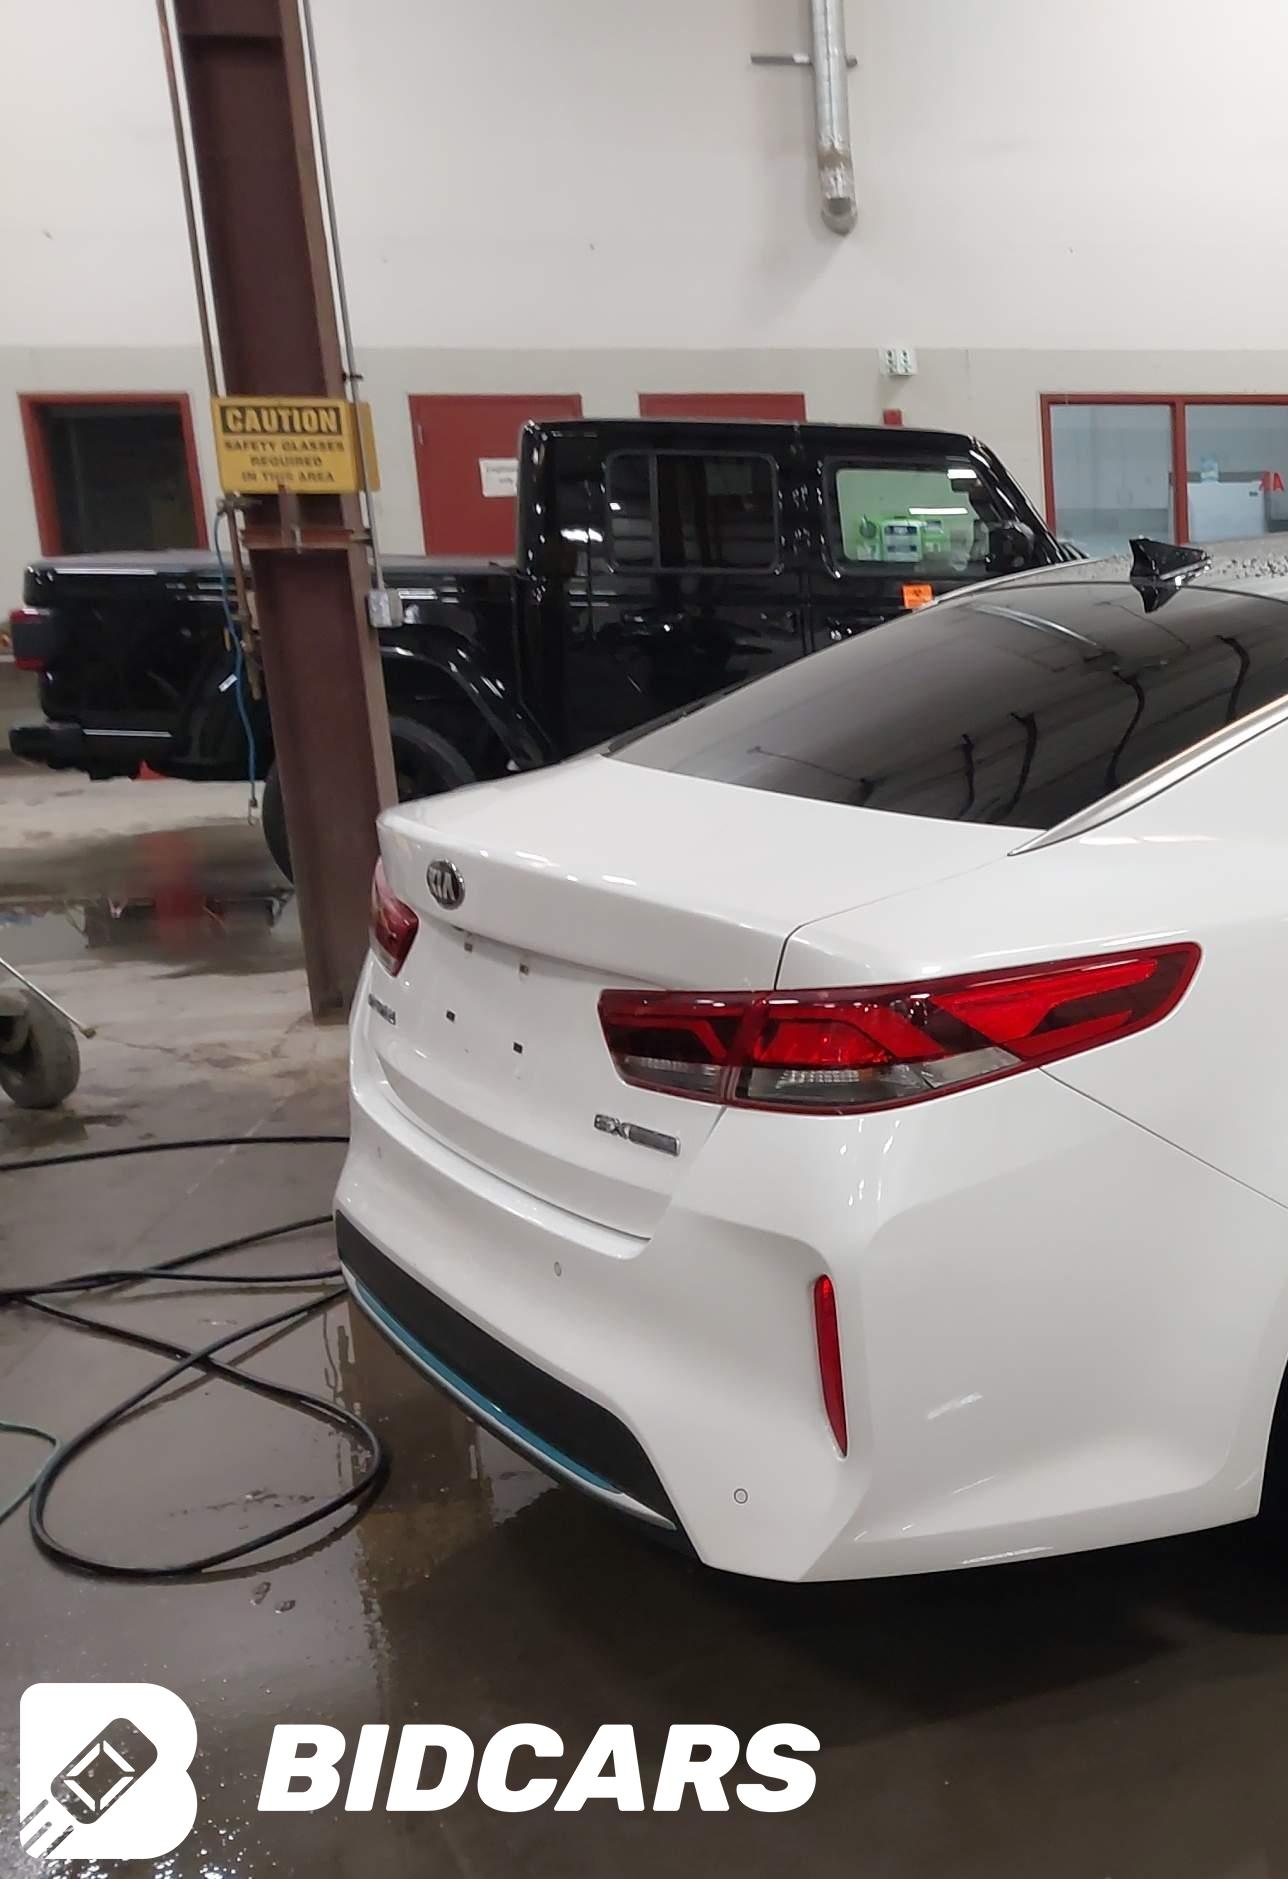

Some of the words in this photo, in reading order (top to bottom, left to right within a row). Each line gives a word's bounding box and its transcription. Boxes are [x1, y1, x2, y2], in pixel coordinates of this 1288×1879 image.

[225, 406, 339, 434] CAUTION
[224, 440, 277, 451] SAFETY
[281, 440, 345, 452] GLASSES
[250, 456, 322, 467] REQUIRED
[241, 471, 258, 482] IN
[298, 471, 335, 482] AREA
[428, 865, 457, 901] KIA
[593, 1113, 629, 1140] EX
